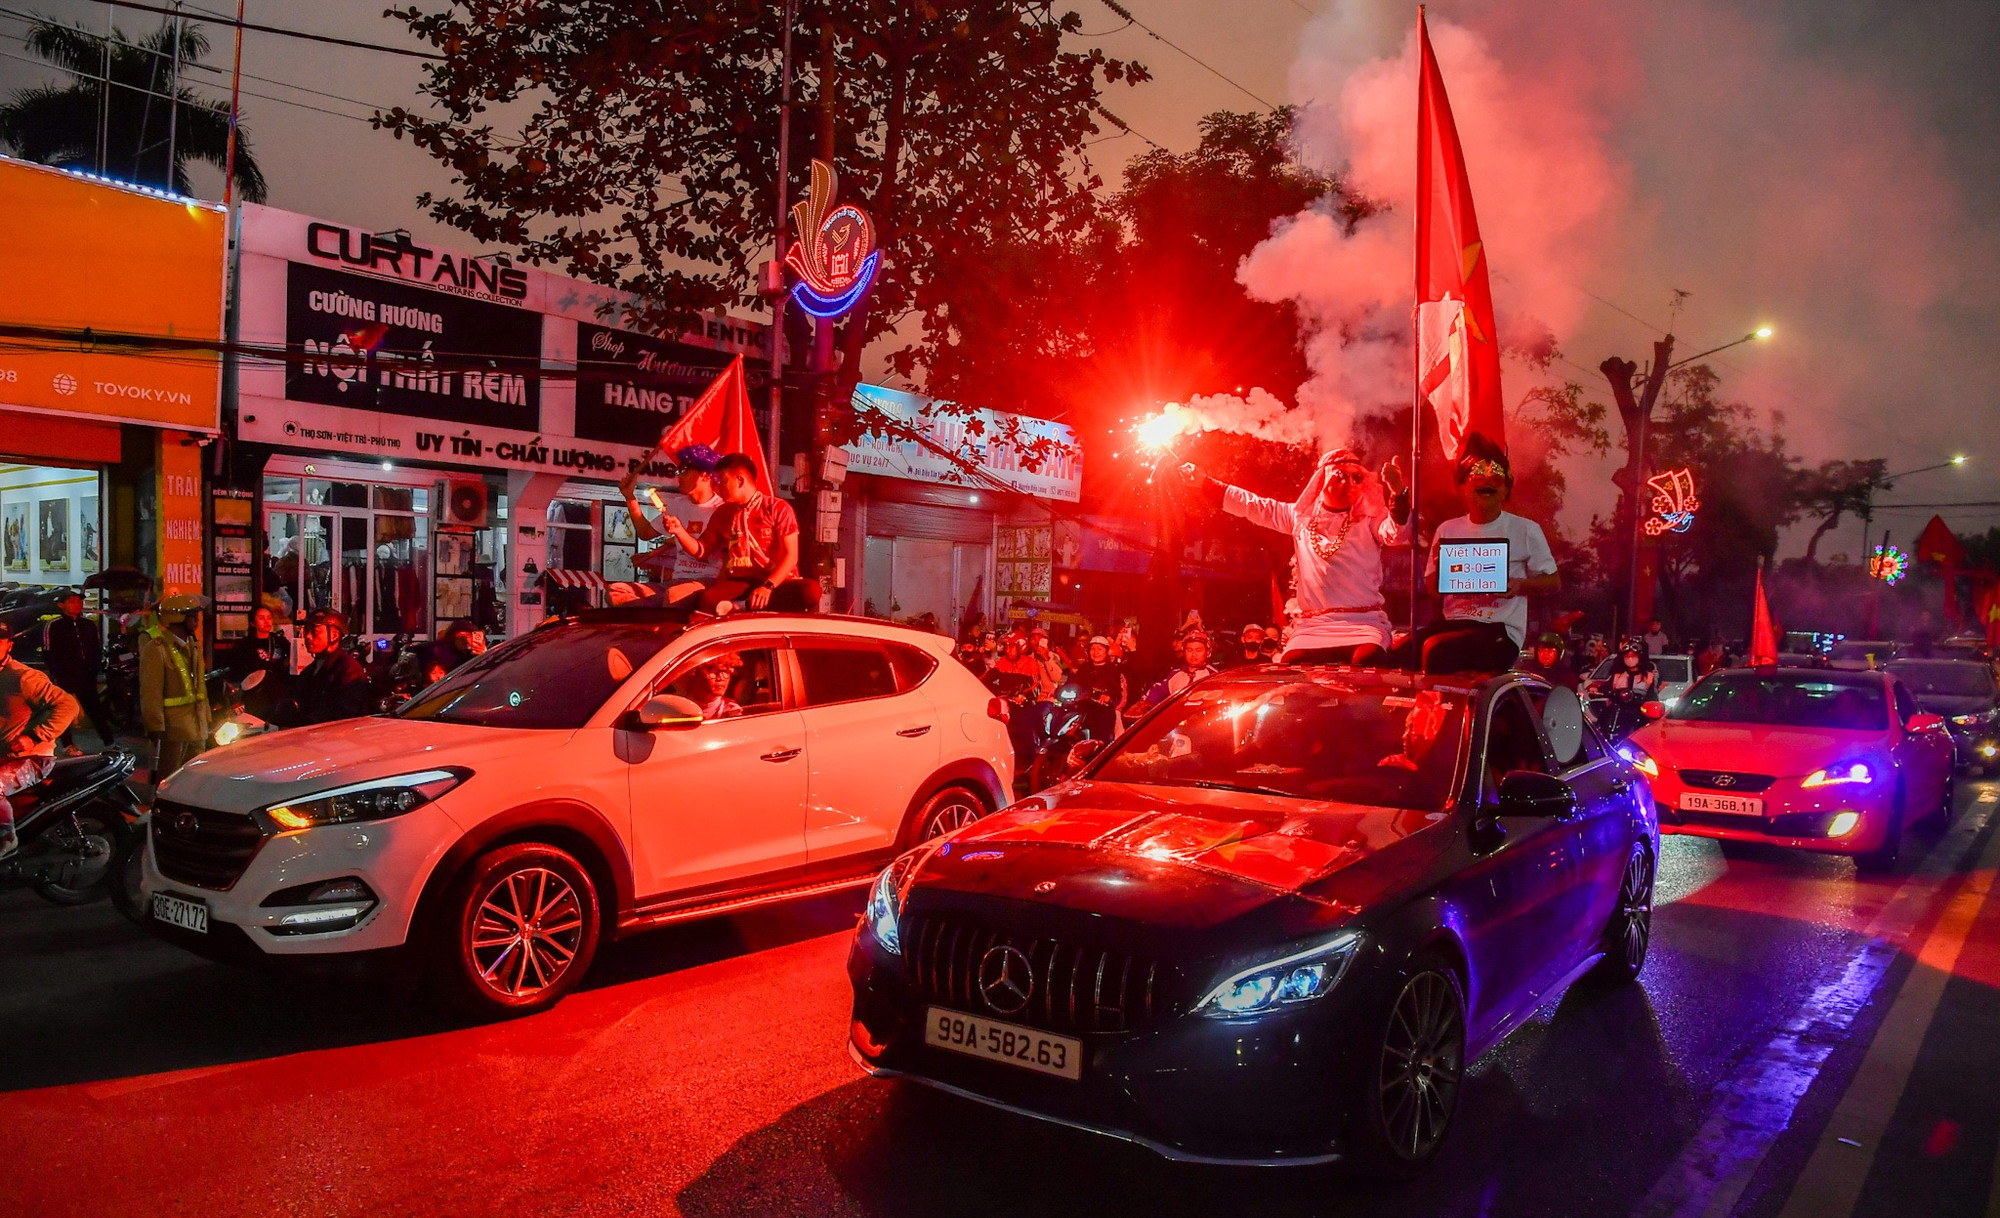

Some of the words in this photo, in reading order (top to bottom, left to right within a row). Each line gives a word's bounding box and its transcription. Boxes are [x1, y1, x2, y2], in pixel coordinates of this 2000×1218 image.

[307, 222, 527, 300] CURTAINS
[437, 283, 475, 298] CURTAINS
[475, 291, 523, 308] COLLECTION
[309, 289, 375, 321] CƯỜNG
[380, 303, 443, 334] HƯƠNG
[591, 331, 625, 360] Shop
[94, 381, 191, 406] TOYOKY.VN
[463, 359, 527, 407] RÈM
[604, 380, 674, 414] HÀNG
[416, 432, 445, 453] UY
[450, 430, 482, 457] TÍN
[495, 436, 549, 464] CHẤT
[553, 448, 615, 474] LƯỢNG
[873, 456, 890, 468] 24/7
[167, 470, 198, 497] TRẢI
[166, 517, 200, 545] NGHIỆM
[1445, 546, 1469, 560] Việt
[1472, 546, 1501, 557] Nam
[1463, 562, 1483, 574] 3-0
[1449, 578, 1475, 590] Thái
[1478, 578, 1497, 590] lan
[1687, 796, 1755, 813] 19A-368.11
[153, 895, 206, 931] 30E-271.72
[937, 1016, 1067, 1069] 99A-582.63
